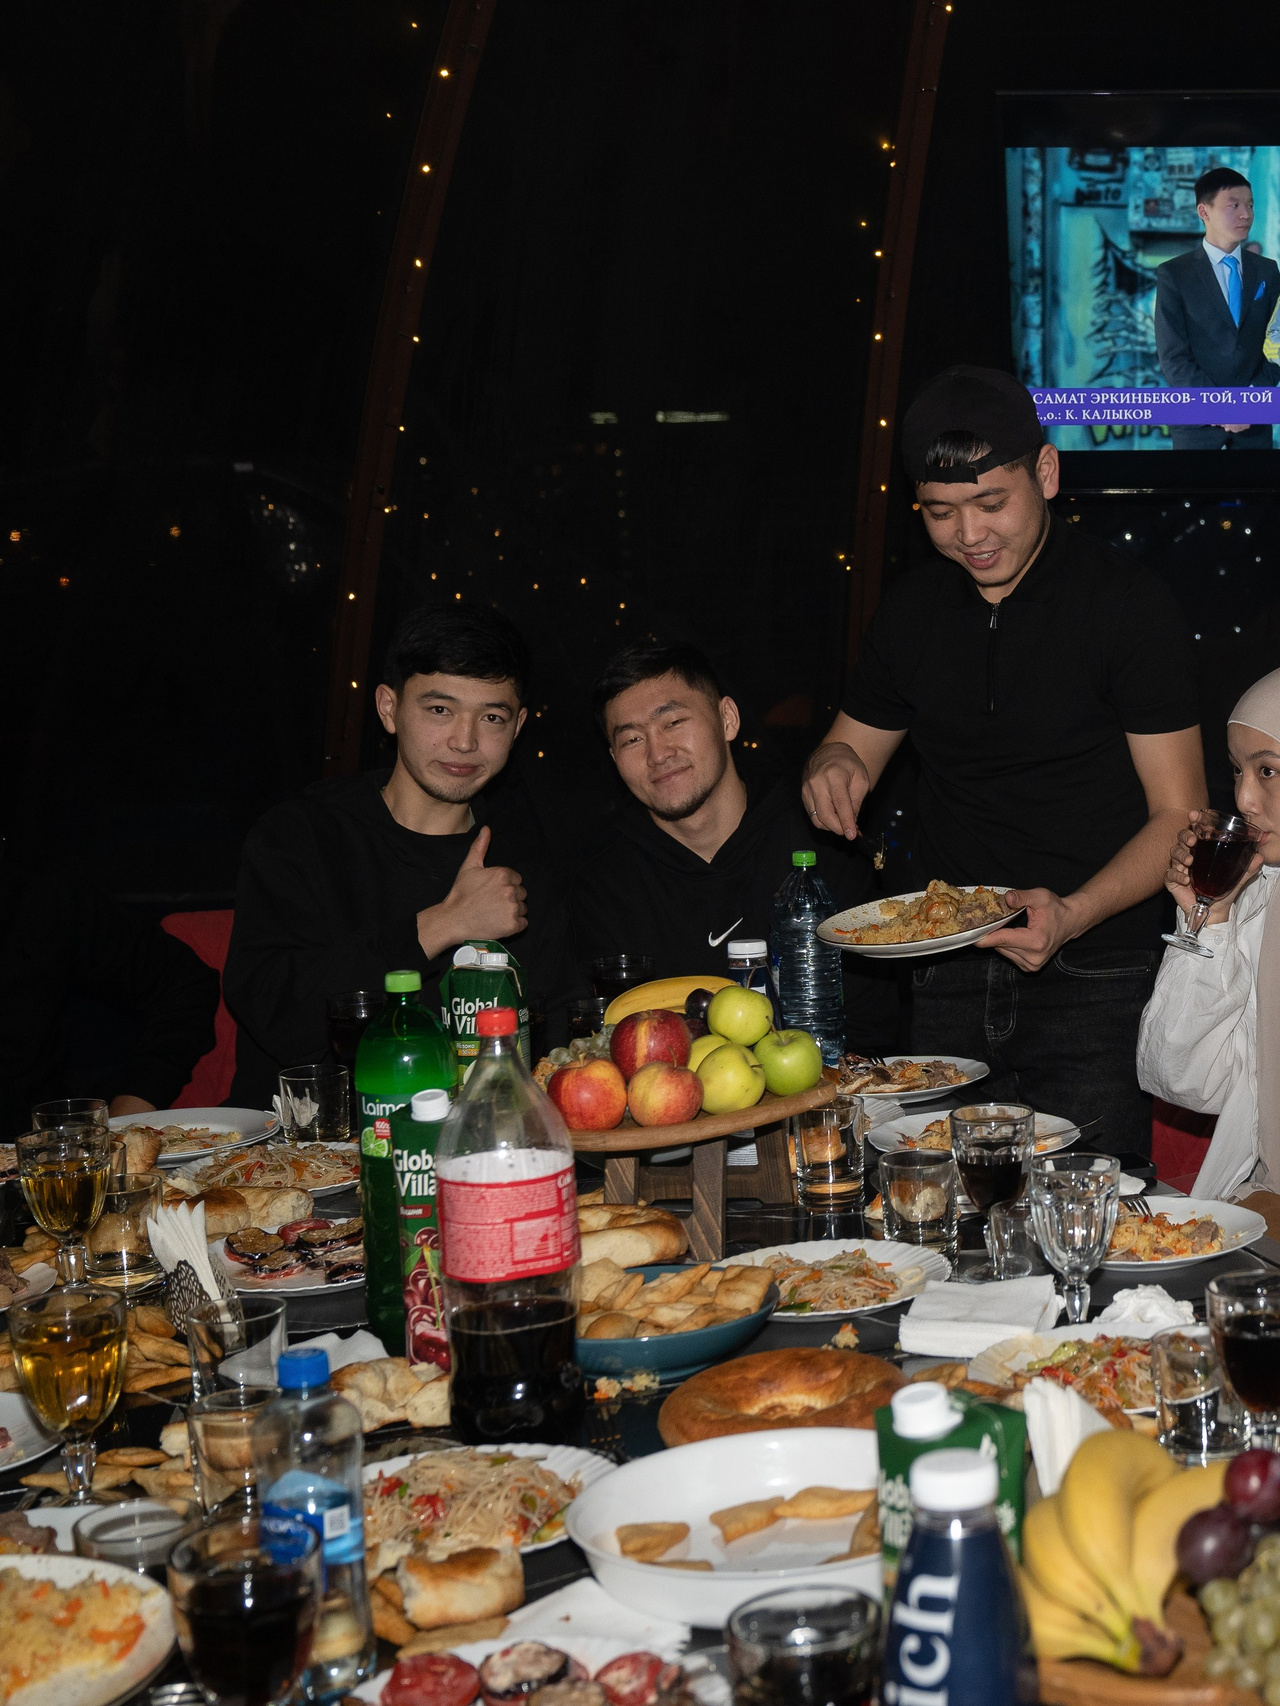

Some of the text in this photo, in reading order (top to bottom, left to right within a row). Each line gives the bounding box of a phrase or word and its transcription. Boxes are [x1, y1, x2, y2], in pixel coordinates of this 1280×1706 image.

[1033, 390, 1273, 405] САМАТ ЭРКИНБЕКОВ- ТОЙ, ТОЙ
[1065, 409, 1078, 420] К.
[1082, 409, 1152, 420] КАЛЫКОВ
[884, 1574, 961, 1706] ich
